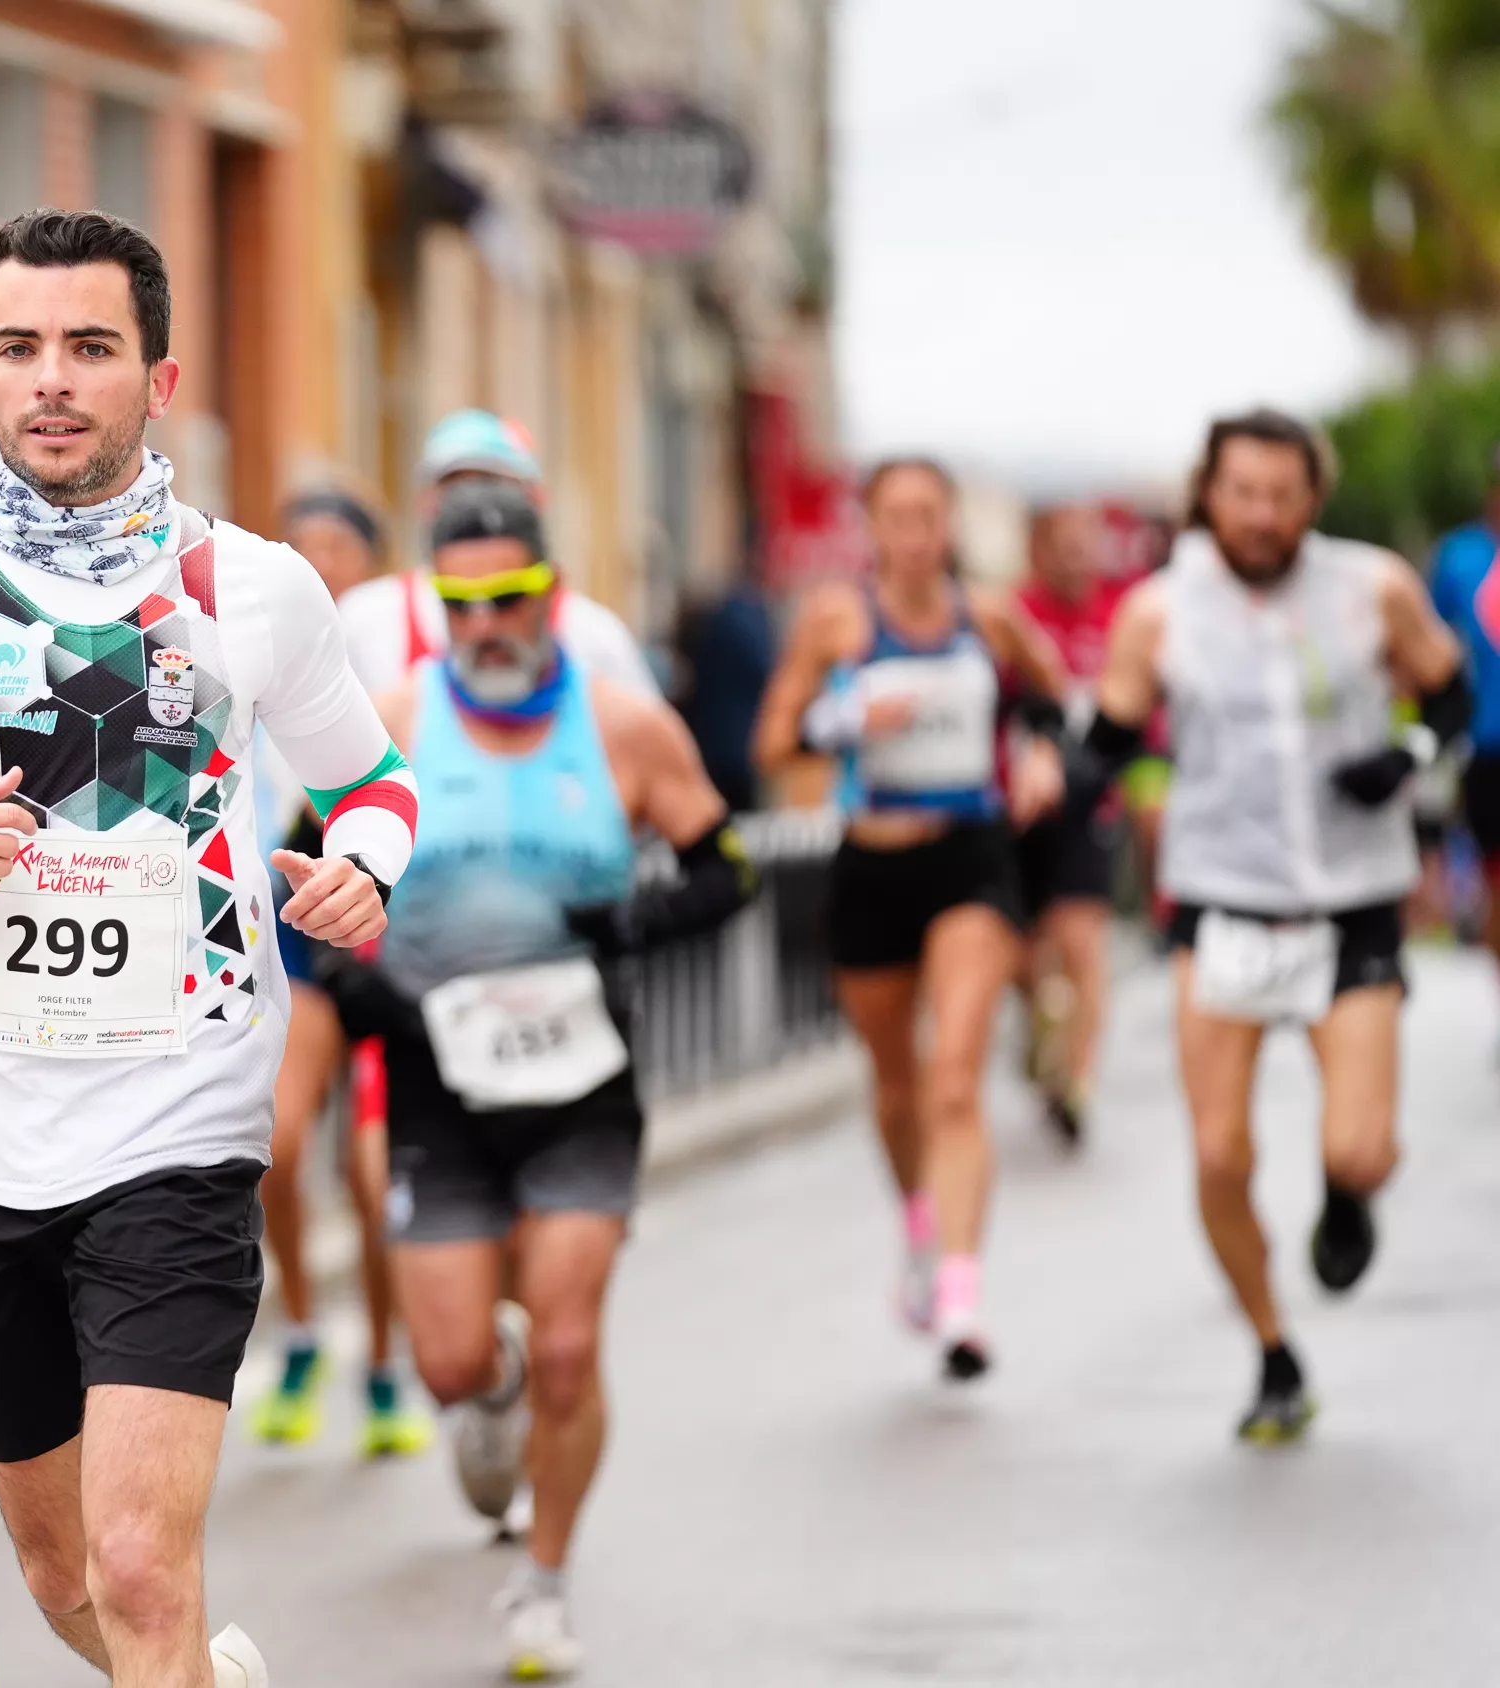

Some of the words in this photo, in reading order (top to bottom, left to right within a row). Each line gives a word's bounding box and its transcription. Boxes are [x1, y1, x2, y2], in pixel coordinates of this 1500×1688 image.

[153, 728, 179, 737] CAÑADA
[37, 869, 115, 896] LUCENA
[6, 914, 129, 978] 299
[37, 995, 63, 1004] JORGE
[65, 996, 92, 1005] FILTER
[42, 1008, 87, 1017] M-Hombre
[96, 1028, 175, 1039] mediamaratonlucena.com
